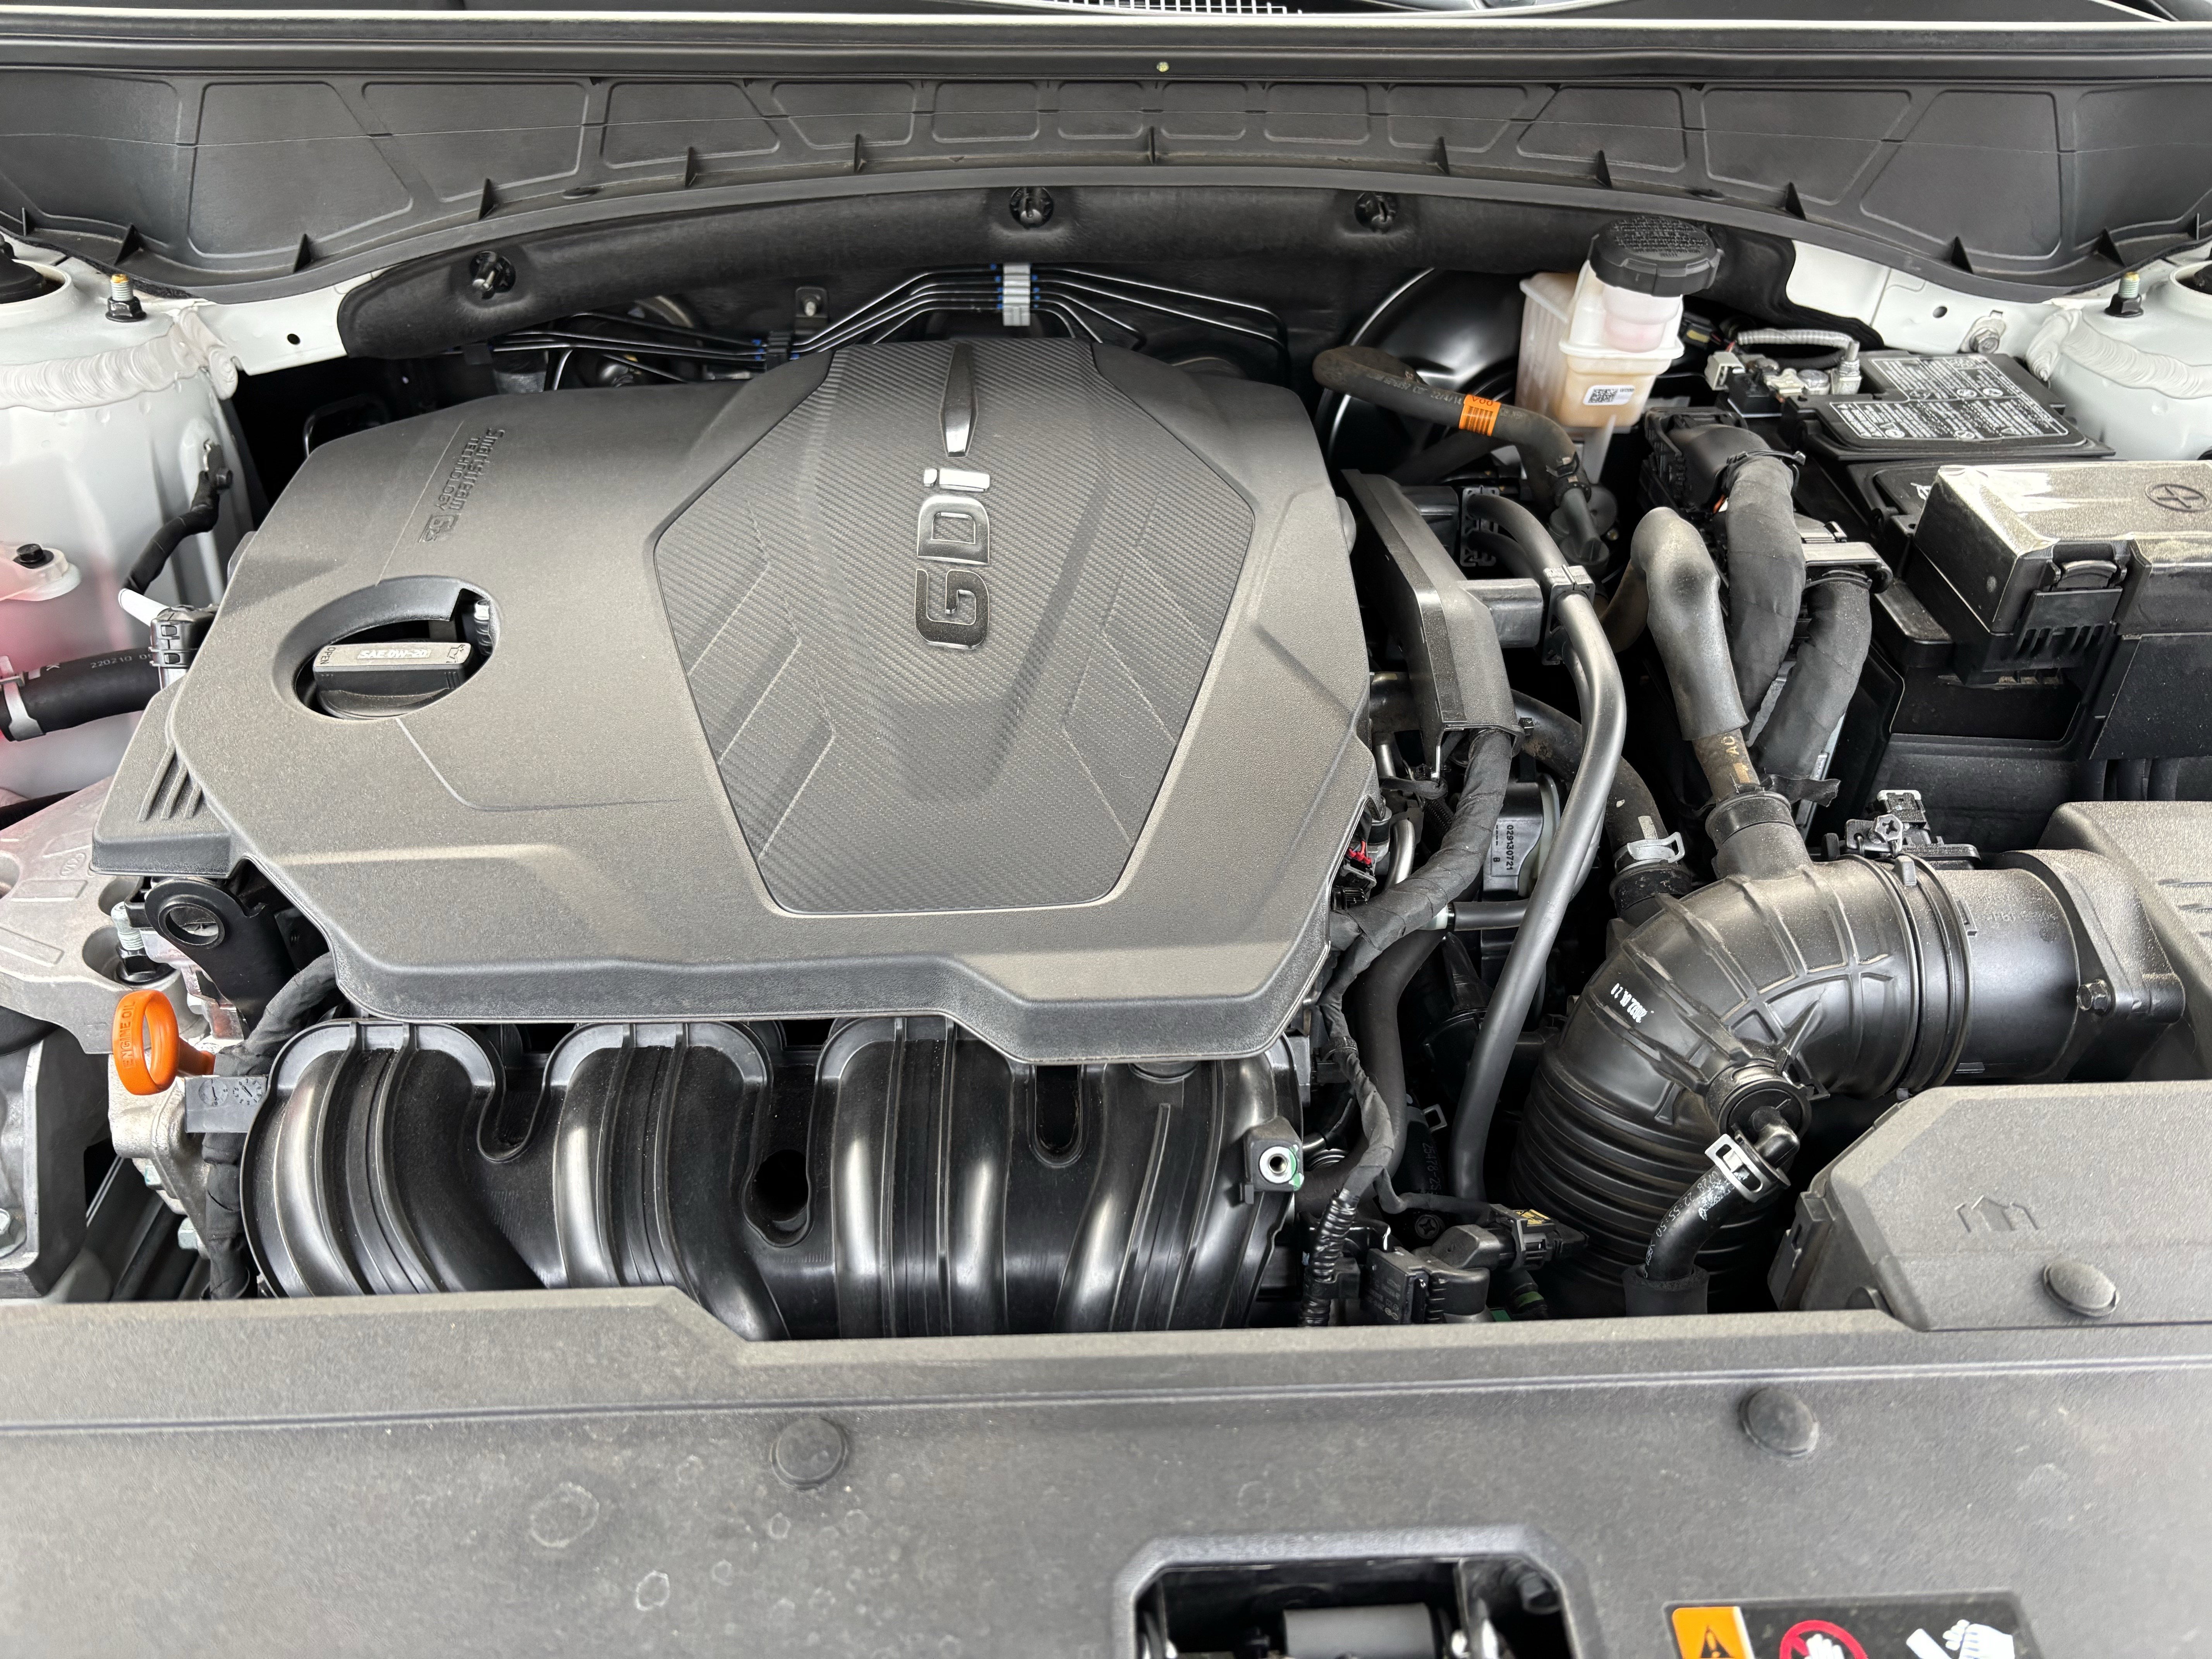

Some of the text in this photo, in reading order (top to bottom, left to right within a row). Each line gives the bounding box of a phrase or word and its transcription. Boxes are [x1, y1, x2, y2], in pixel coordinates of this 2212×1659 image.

[433, 437, 481, 511] TECHNOLOGY
[914, 468, 991, 650] GDi
[320, 647, 336, 665] OPEN
[360, 649, 428, 659] SAE 0W-20
[1506, 824, 1514, 871] 029130721
[120, 1001, 136, 1069] ENGINE OIL
